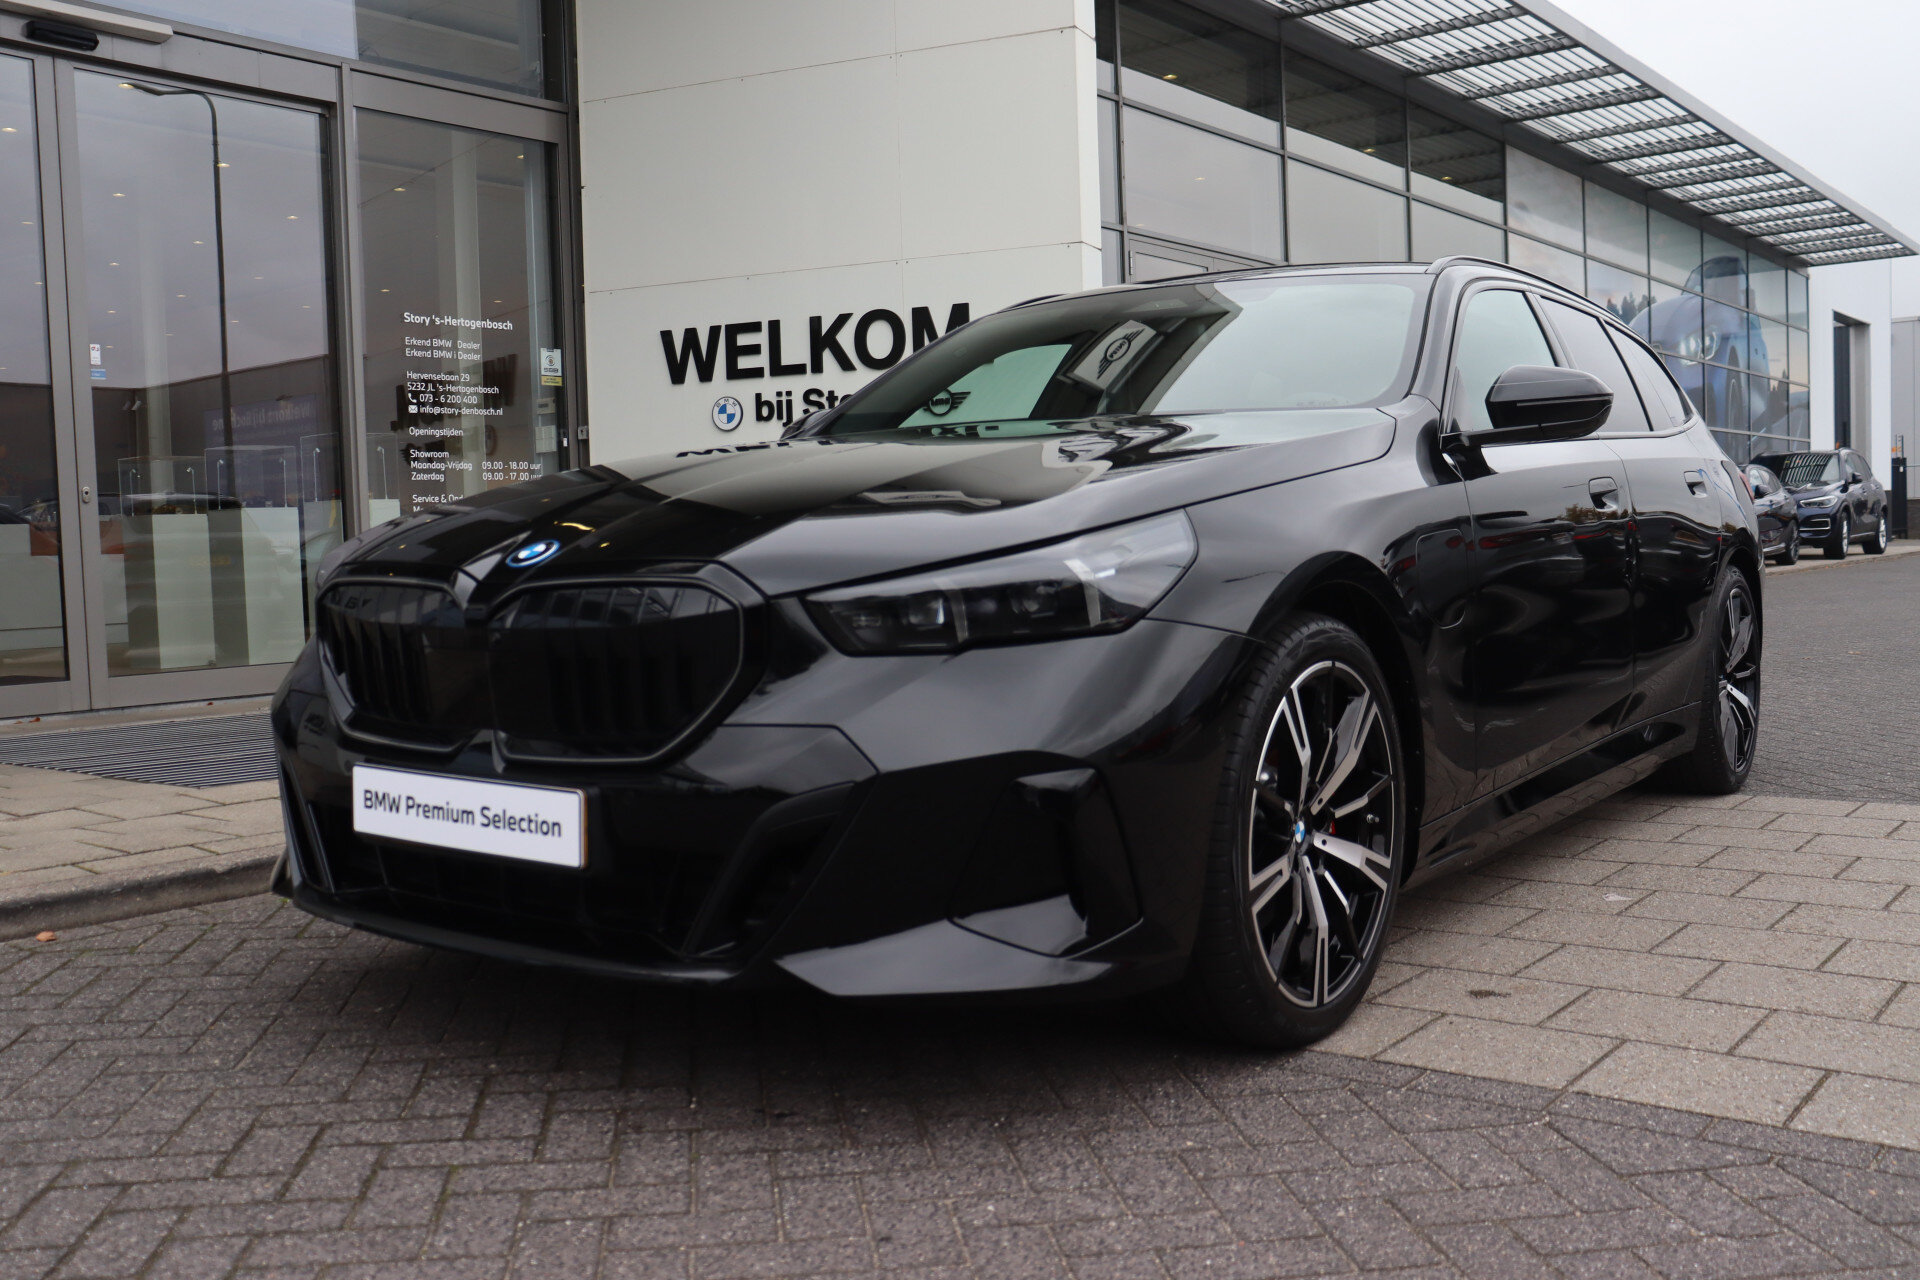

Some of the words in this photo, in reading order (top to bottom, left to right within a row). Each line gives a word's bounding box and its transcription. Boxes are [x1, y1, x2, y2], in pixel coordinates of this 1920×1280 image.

[403, 312, 430, 326] Story
[432, 315, 513, 330] 's-Hertogenbosch
[405, 337, 431, 347] Erkend
[433, 339, 452, 348] BMW
[458, 341, 480, 350] Dealer
[659, 302, 970, 385] WELKOM
[406, 348, 432, 358] Erkend
[434, 350, 452, 358] BMW
[458, 352, 480, 360] Dealer
[407, 371, 460, 381] Hervensebaan
[408, 382, 426, 390] 5232
[427, 383, 435, 391] JL
[436, 384, 499, 394] 's-Hertogenbosch
[420, 394, 433, 402] 073
[446, 395, 460, 403] 200
[420, 405, 504, 416] info@story-denbosch.nl
[755, 391, 793, 427] bij
[803, 388, 853, 414] St
[409, 427, 464, 438] Openingstijden
[410, 450, 449, 458] Showroom
[411, 462, 472, 471] Maandag-Vrijdag
[412, 472, 444, 482] Zaterdag
[413, 495, 440, 503] Service
[364, 790, 400, 813] BMW
[406, 796, 475, 825] Premium
[480, 806, 562, 838] Selection
